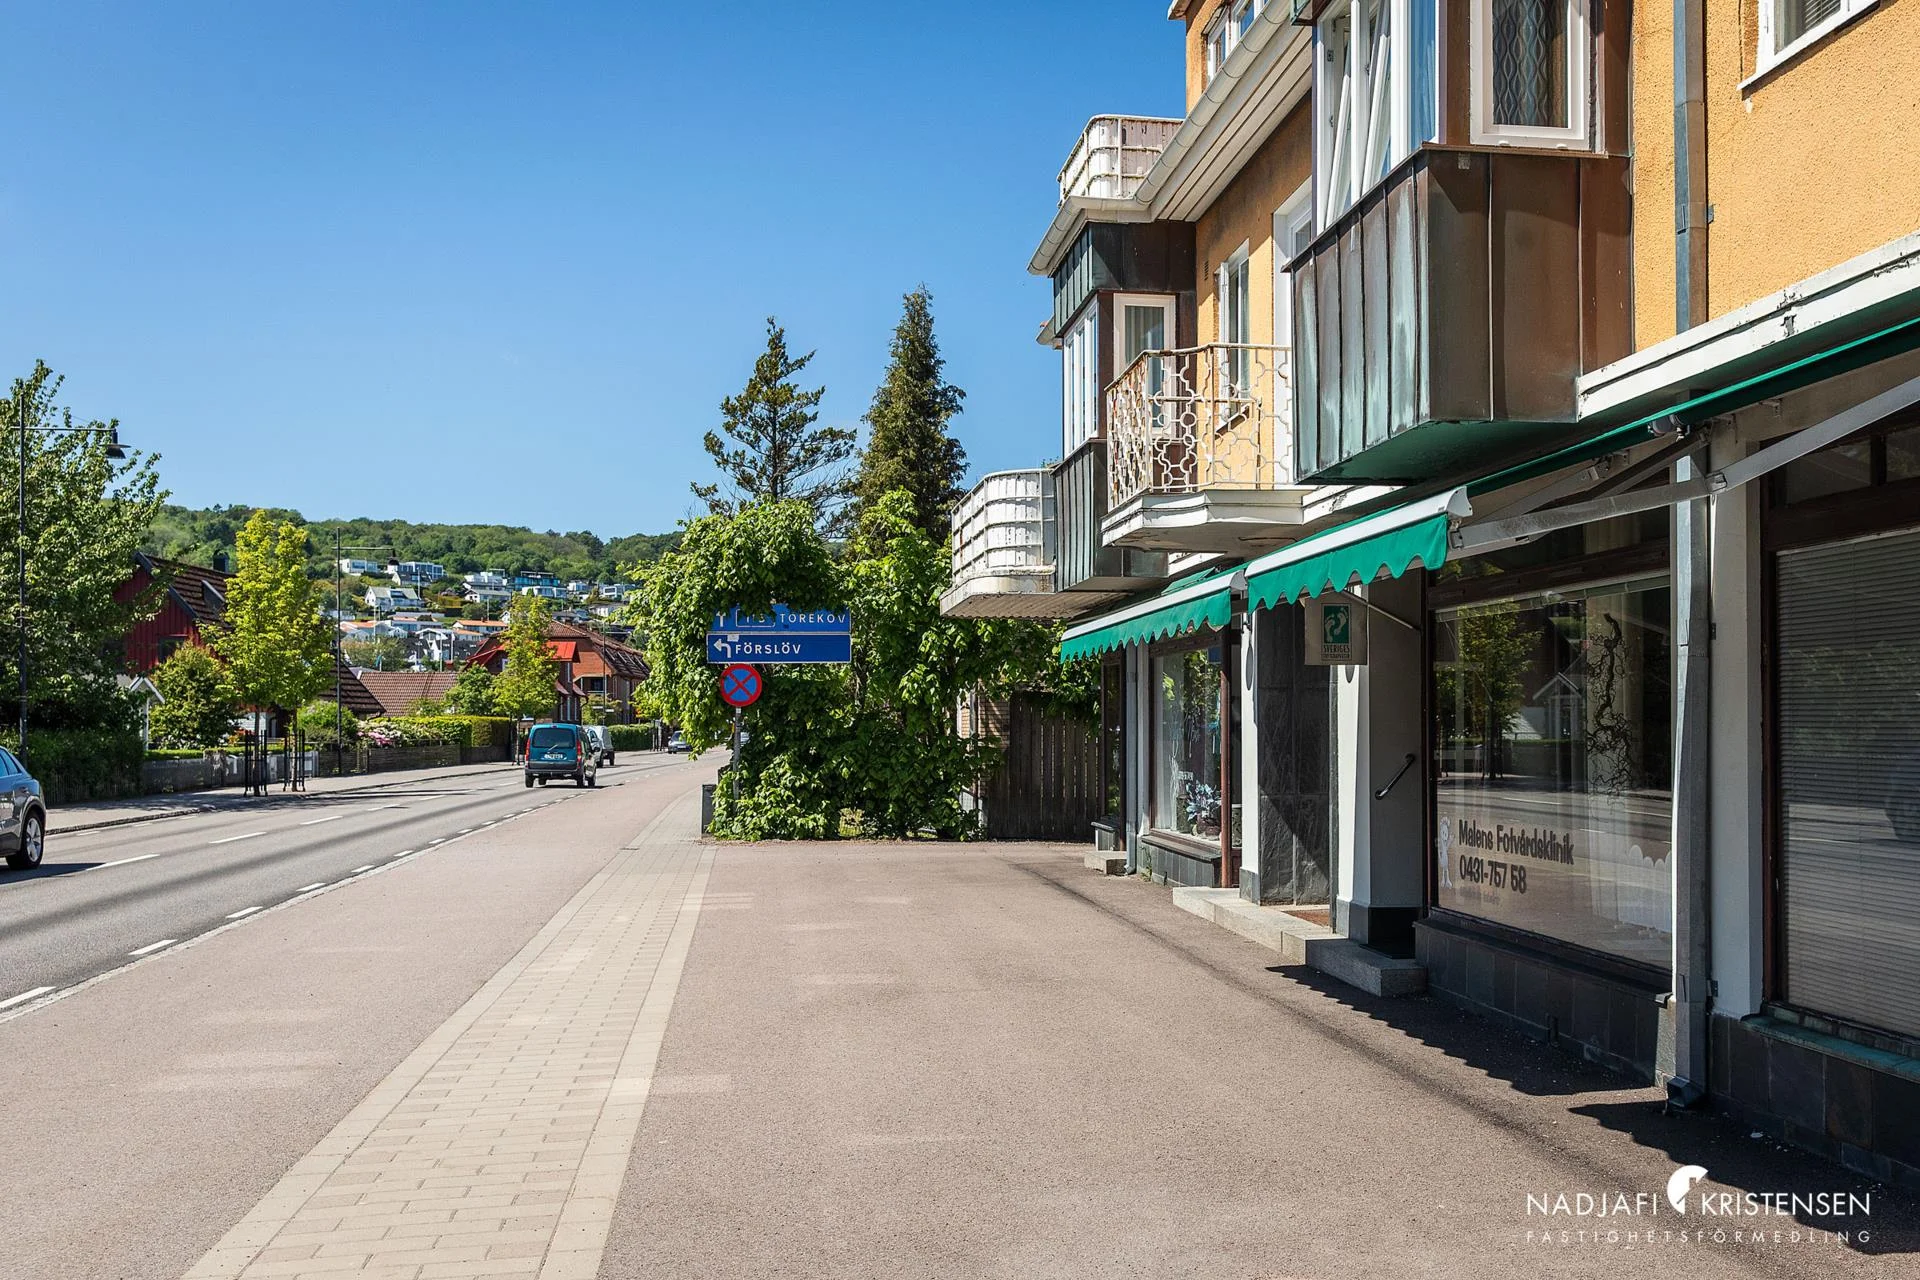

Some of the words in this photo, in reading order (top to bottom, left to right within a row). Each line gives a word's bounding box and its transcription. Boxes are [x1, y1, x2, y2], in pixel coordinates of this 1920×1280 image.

[779, 613, 846, 623] TOREKOV
[735, 642, 801, 655] FÖRSLÖV
[1458, 819, 1493, 850] Malens
[1496, 824, 1574, 865] Fotvårdsklinik
[1460, 855, 1507, 889] 0431-757
[1511, 864, 1527, 894] 58
